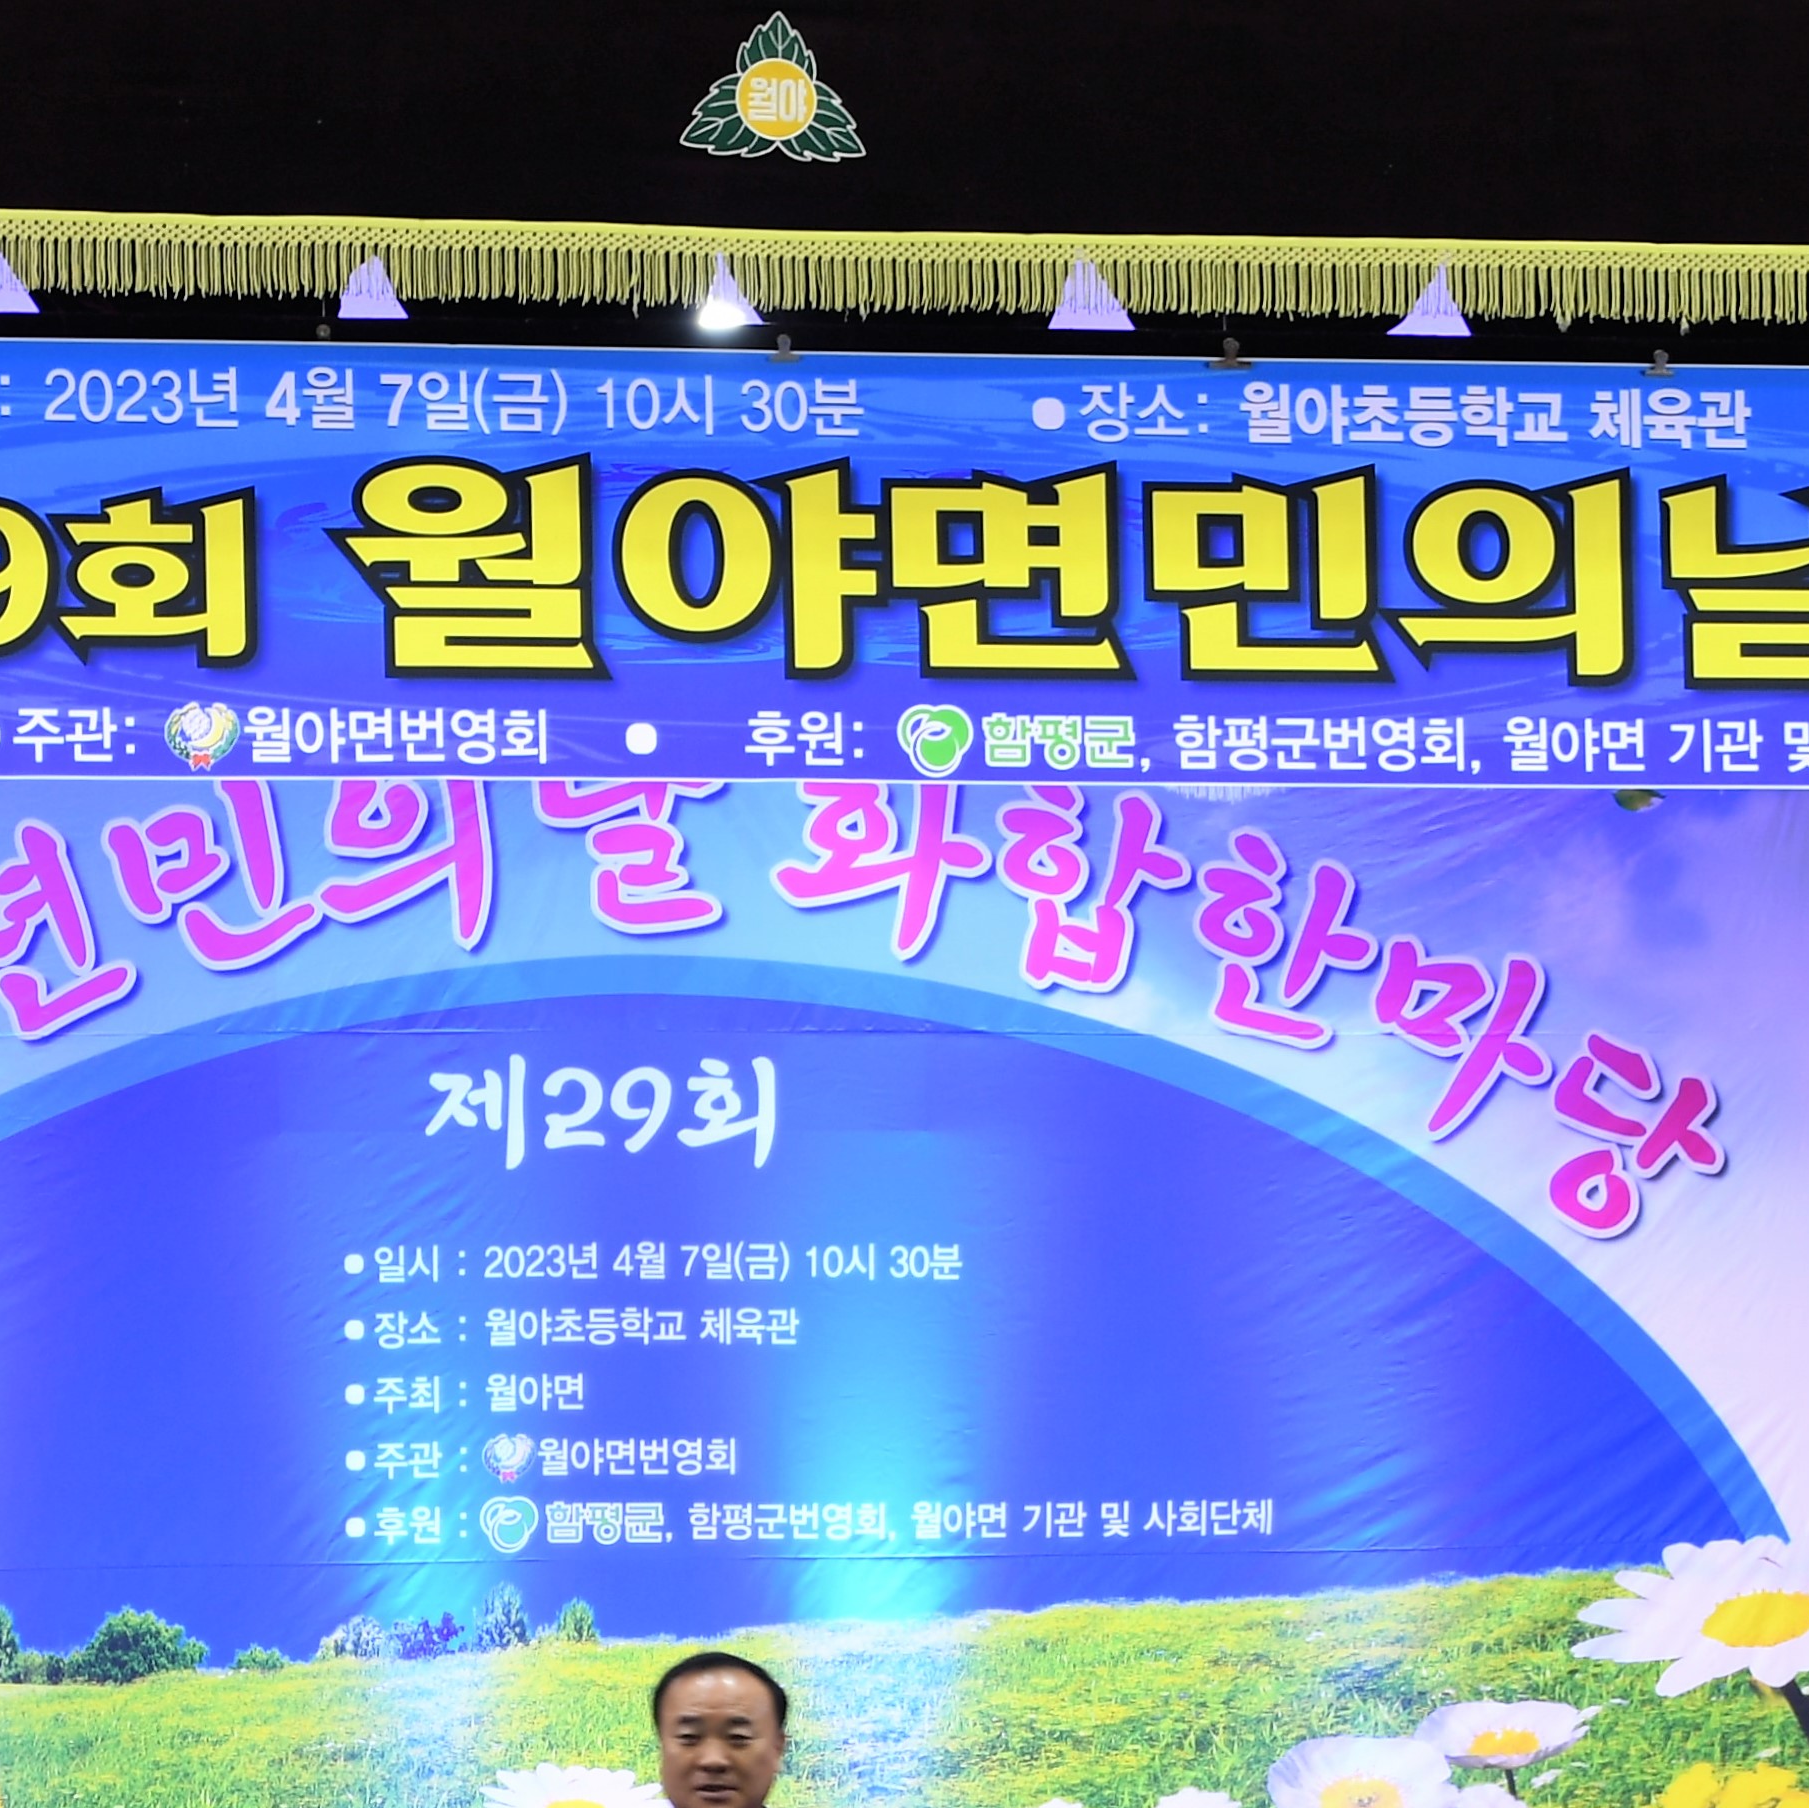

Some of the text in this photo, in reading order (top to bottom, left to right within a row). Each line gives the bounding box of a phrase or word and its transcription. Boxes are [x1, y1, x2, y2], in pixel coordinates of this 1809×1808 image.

[747, 76, 808, 123] 월야
[44, 366, 239, 429] 2023년
[265, 366, 356, 431] 4월
[379, 367, 569, 436] 7일(금)
[596, 373, 715, 436] 10시
[740, 377, 866, 437] 30분
[1239, 380, 1569, 448] 월야초등학교
[1589, 388, 1753, 450] 체육관
[243, 705, 549, 765] 월야면번영회
[1173, 714, 1480, 775] 함평군번영회,
[1503, 715, 1646, 773] 월야면
[1667, 717, 1763, 773] 기관
[425, 1053, 776, 1171] 제29회
[373, 1244, 441, 1282] 일시
[483, 1242, 599, 1280] 2023년
[612, 1241, 667, 1280] 4월
[680, 1241, 791, 1282] 7일(금)
[805, 1242, 877, 1281] 10시
[890, 1243, 964, 1280] 30분
[373, 1310, 442, 1349] 장소
[485, 1308, 687, 1348] 월야초등학교
[700, 1308, 800, 1346] 체육관
[373, 1375, 441, 1413] 주최
[485, 1373, 586, 1412] 월야면
[373, 1440, 443, 1480] 주관
[538, 1437, 737, 1477] 월야면번영회
[373, 1505, 442, 1544] 후원
[911, 1500, 1007, 1539] 월야면
[1023, 1500, 1087, 1538] 기관
[1101, 1499, 1131, 1538] 및
[1143, 1498, 1274, 1537] 사회단체
